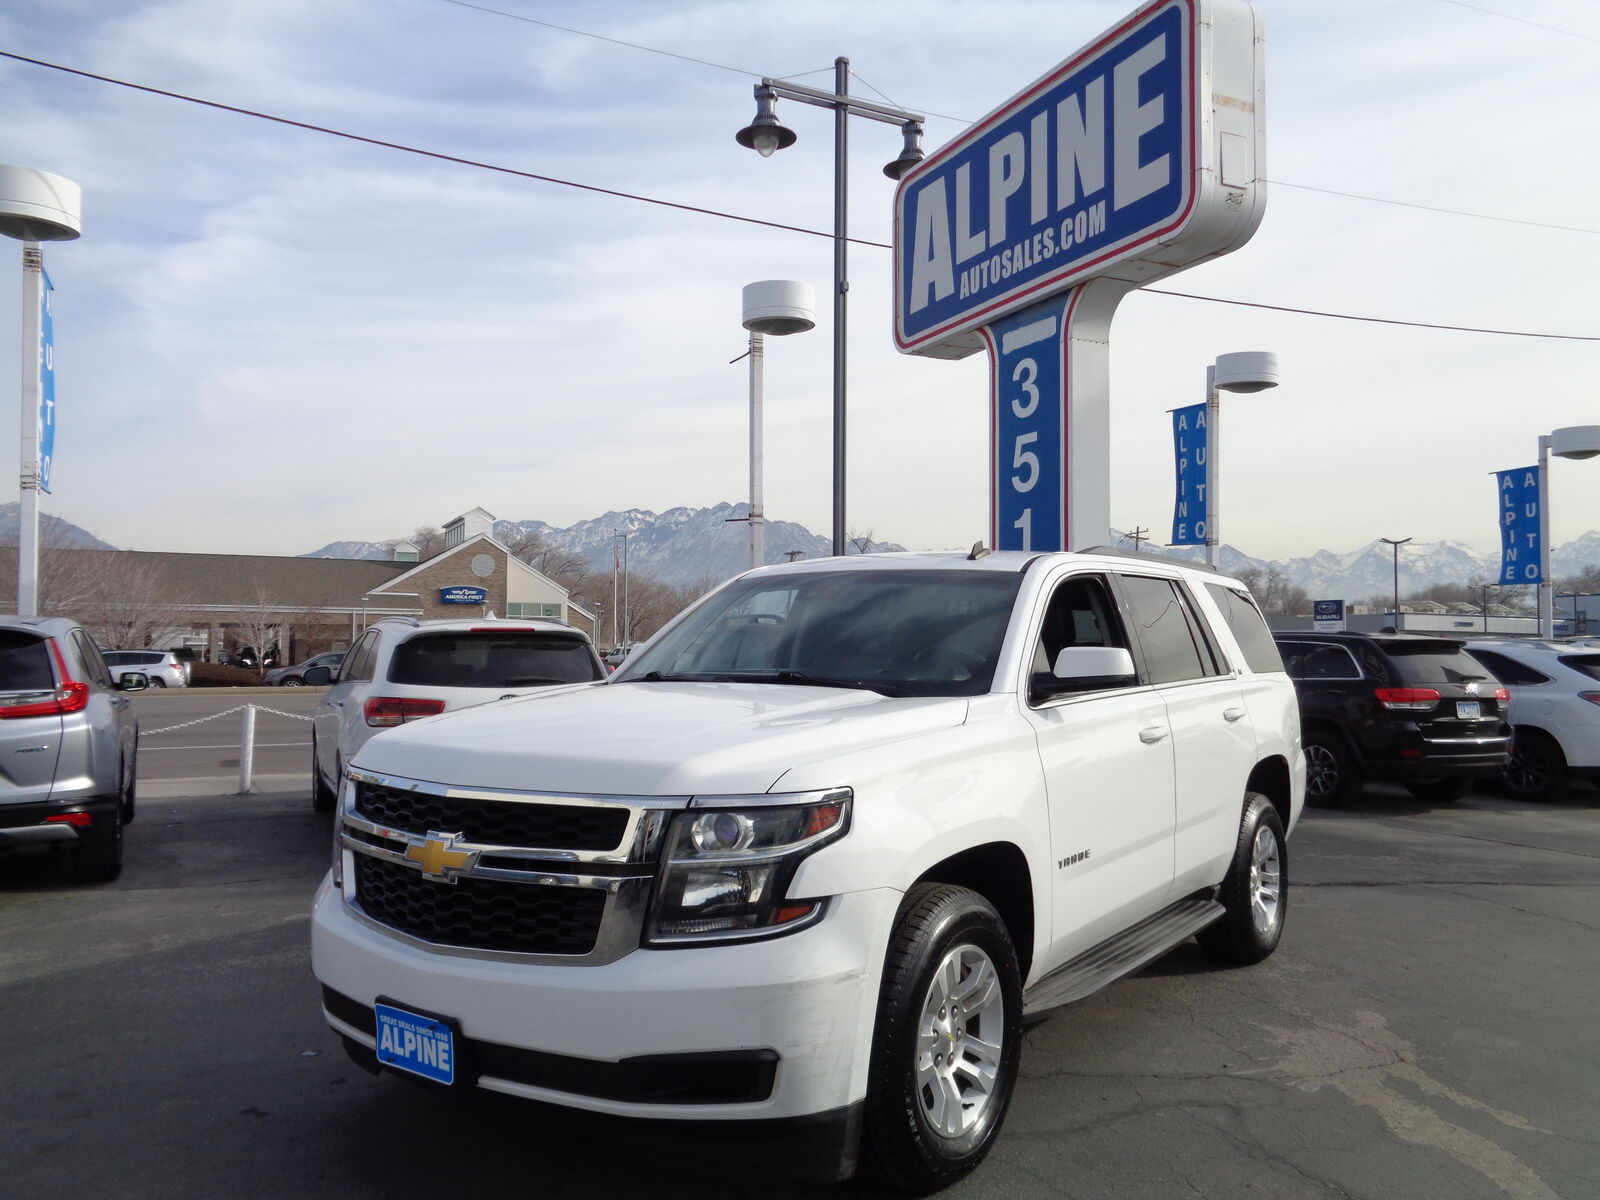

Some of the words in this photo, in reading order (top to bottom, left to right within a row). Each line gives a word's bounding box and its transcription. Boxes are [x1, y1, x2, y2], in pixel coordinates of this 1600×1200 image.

[909, 32, 1170, 315] ALPINE
[959, 200, 1106, 300] AUTOSALES.COM
[1178, 414, 1188, 539] ALPINE
[1194, 410, 1206, 539] AUTO
[1524, 472, 1538, 579] AUTO
[1502, 475, 1517, 580] ALPINE
[1058, 848, 1090, 870] TAHOE
[380, 1024, 450, 1072] ALPINE
[398, 1019, 415, 1032] DEALS
[416, 1026, 433, 1038] SINCE
